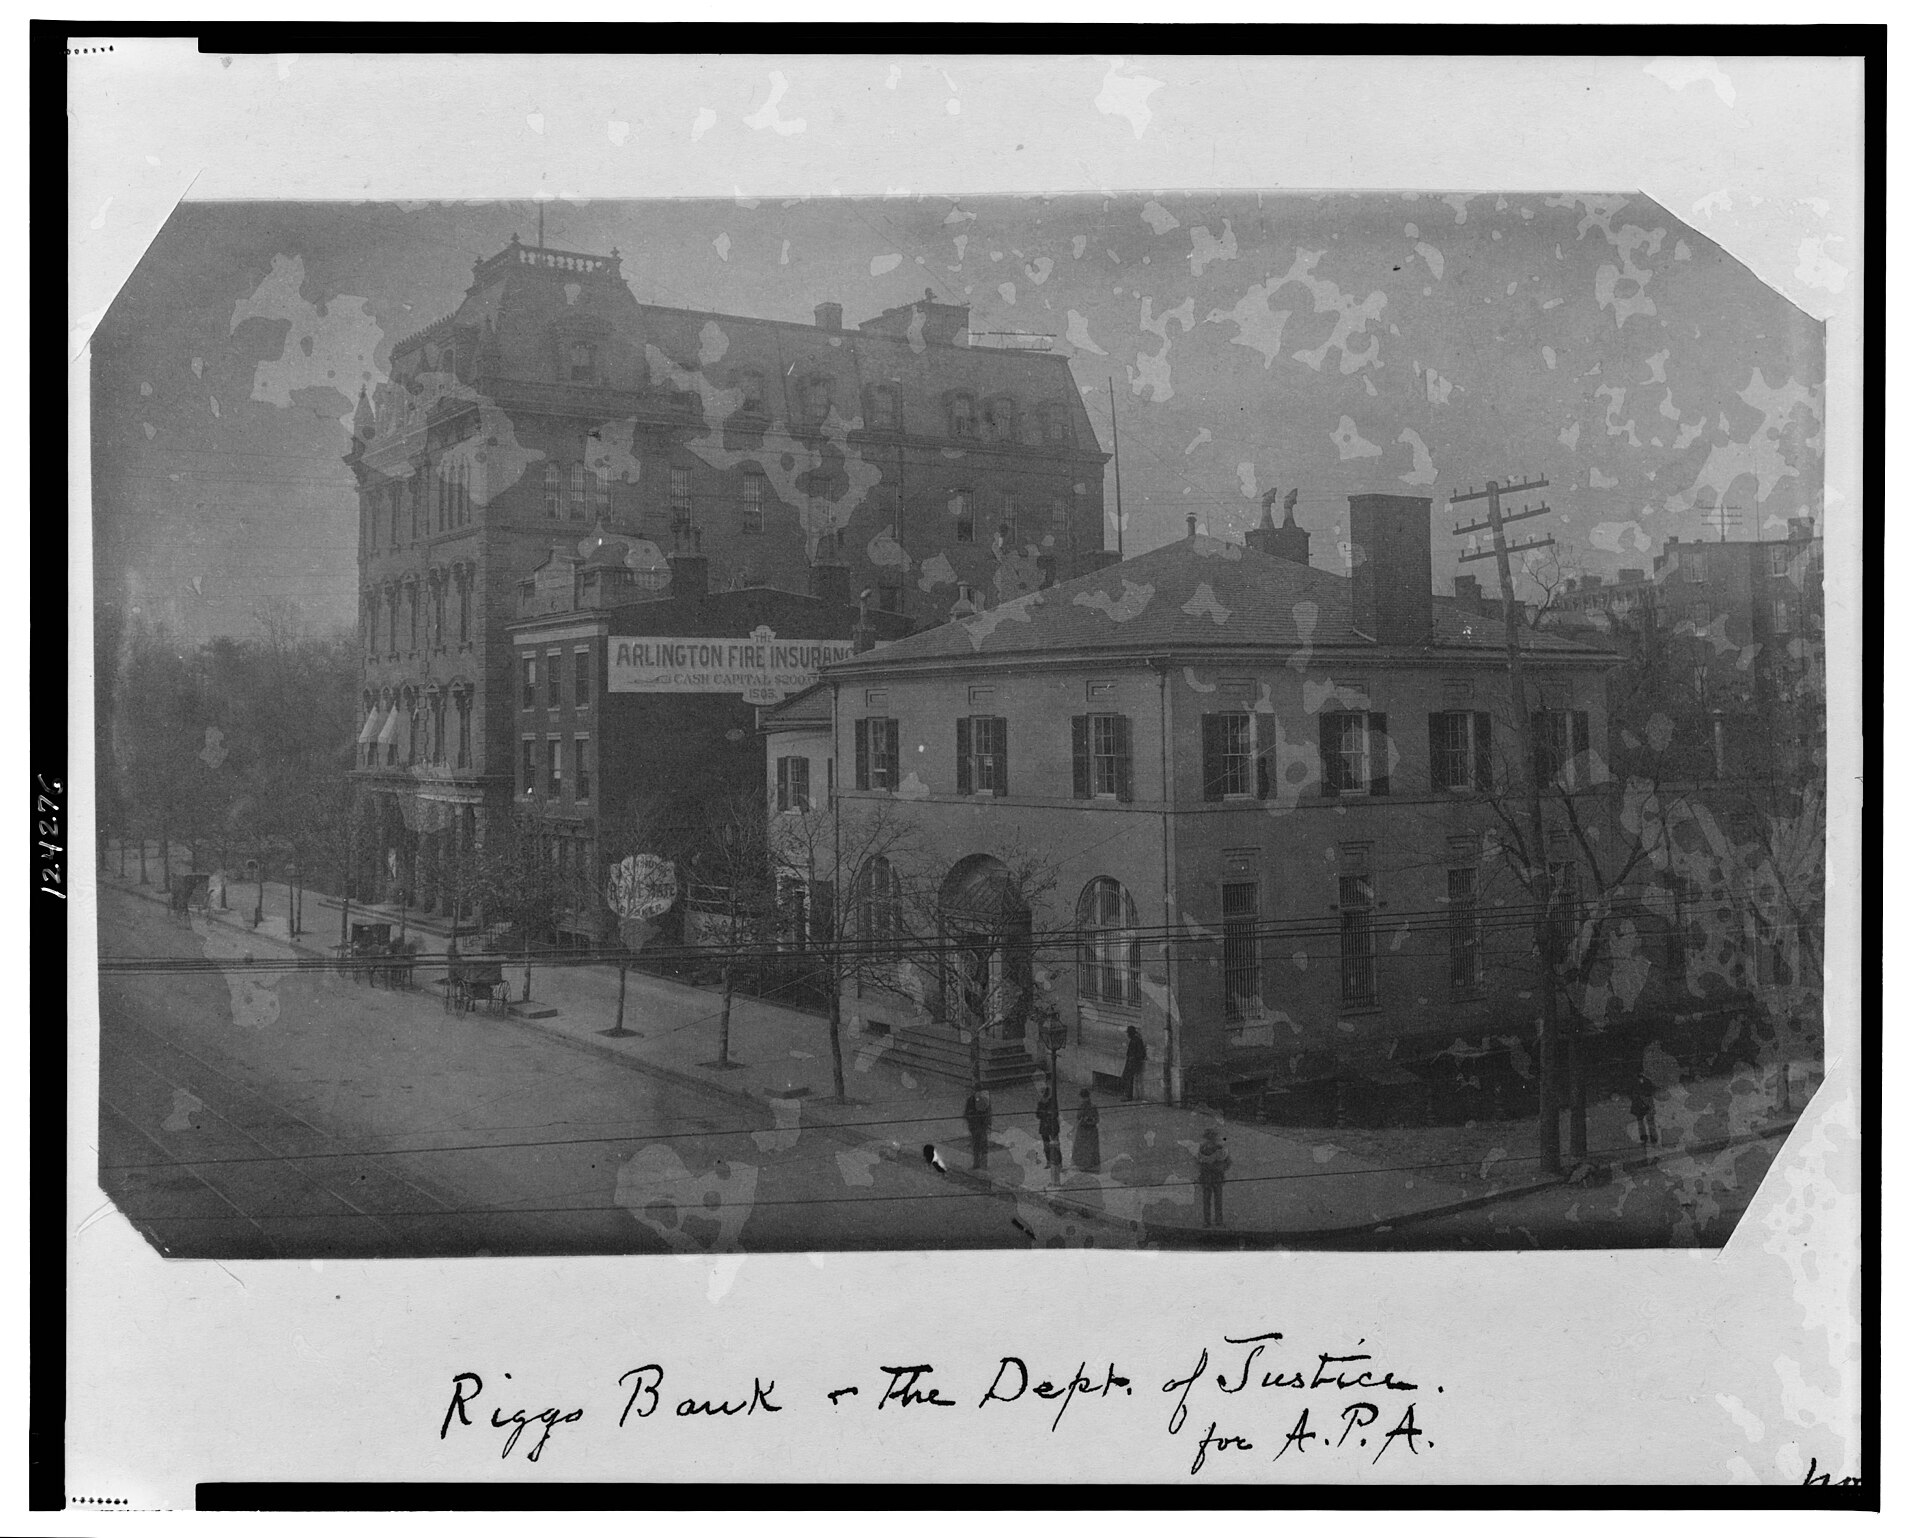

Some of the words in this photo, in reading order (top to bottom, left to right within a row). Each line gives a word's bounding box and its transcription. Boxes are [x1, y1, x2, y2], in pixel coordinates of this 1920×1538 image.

[754, 631, 773, 644] THE
[616, 643, 723, 668] ARLINGTON
[728, 645, 766, 668] FIRE
[673, 673, 709, 685] CASH
[714, 673, 771, 686] CAPITAL
[440, 1372, 584, 1463] Riggs
[618, 1363, 783, 1428] Bank
[978, 1356, 1132, 1432] Dept.
[1161, 1347, 1208, 1436] of
[1190, 1421, 1253, 1475] for
